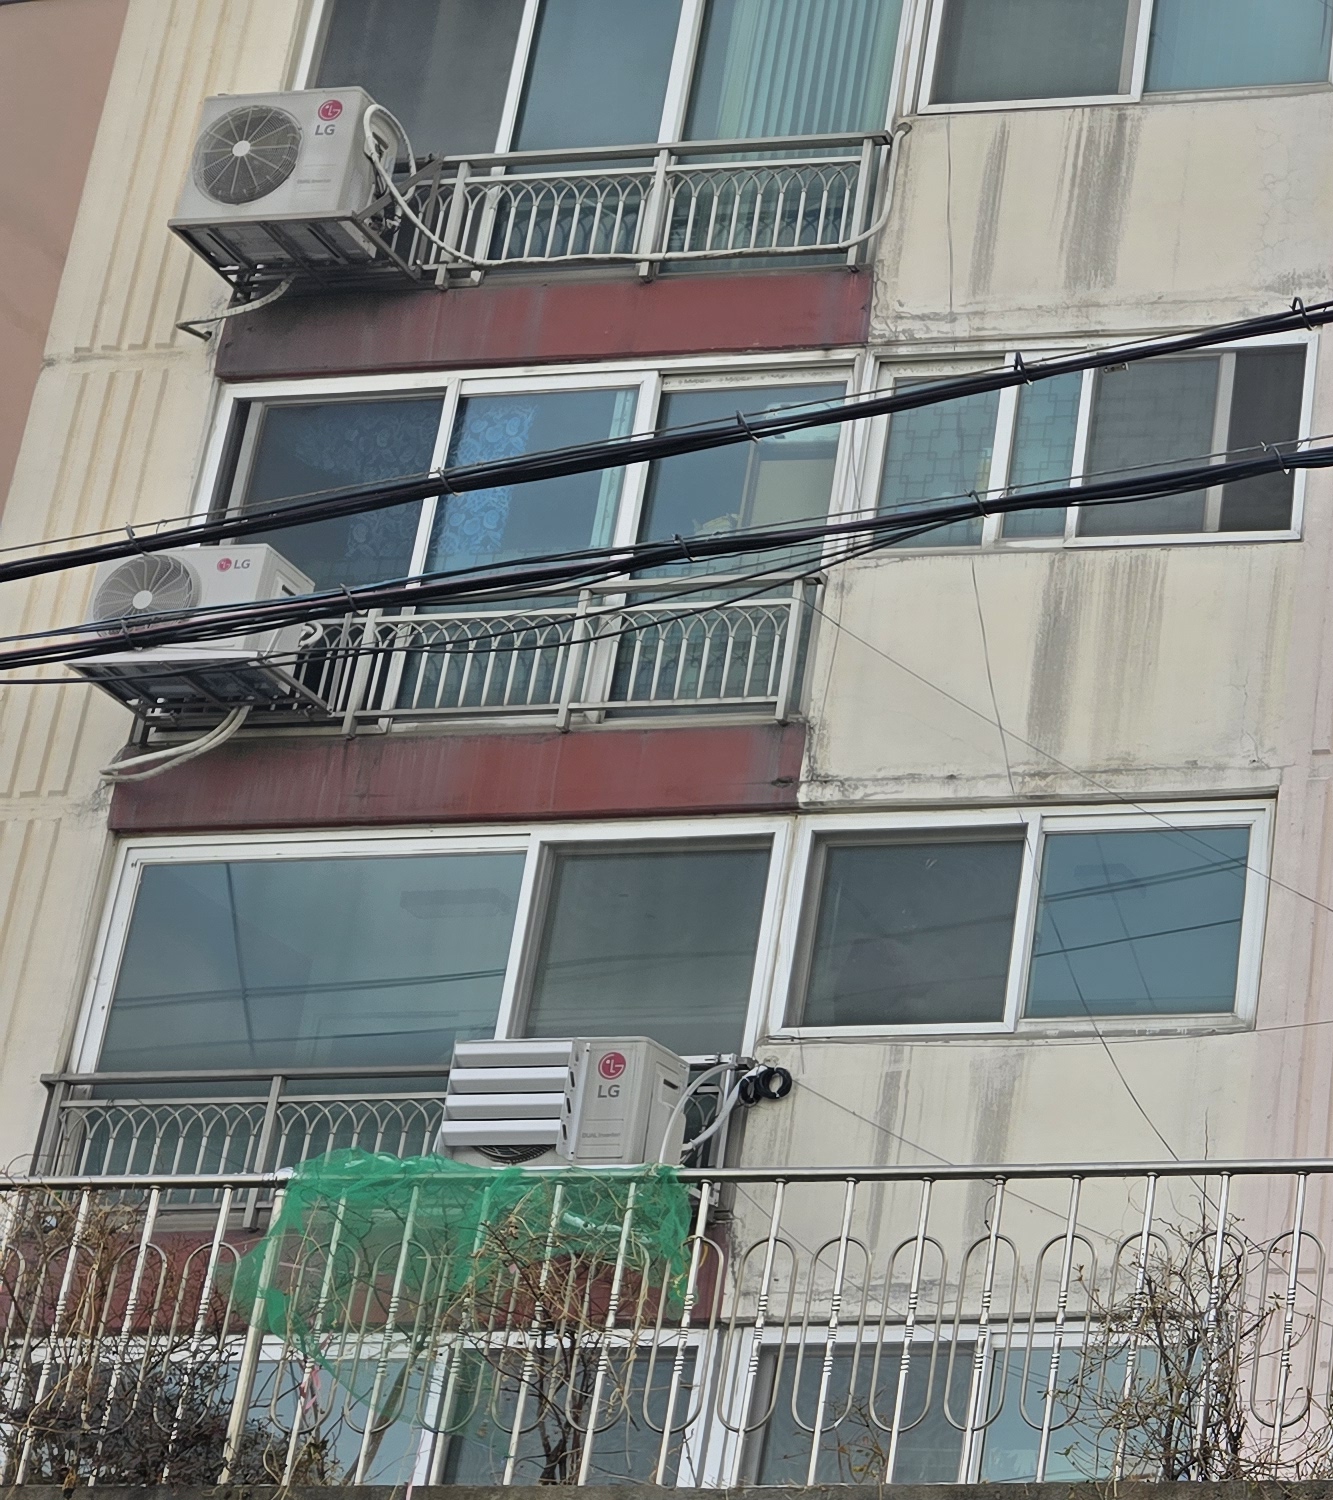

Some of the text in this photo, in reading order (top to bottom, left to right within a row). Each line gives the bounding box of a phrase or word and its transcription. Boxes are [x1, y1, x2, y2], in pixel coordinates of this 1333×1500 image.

[314, 124, 336, 136] LG
[233, 558, 251, 570] LG
[597, 1084, 620, 1099] LG
